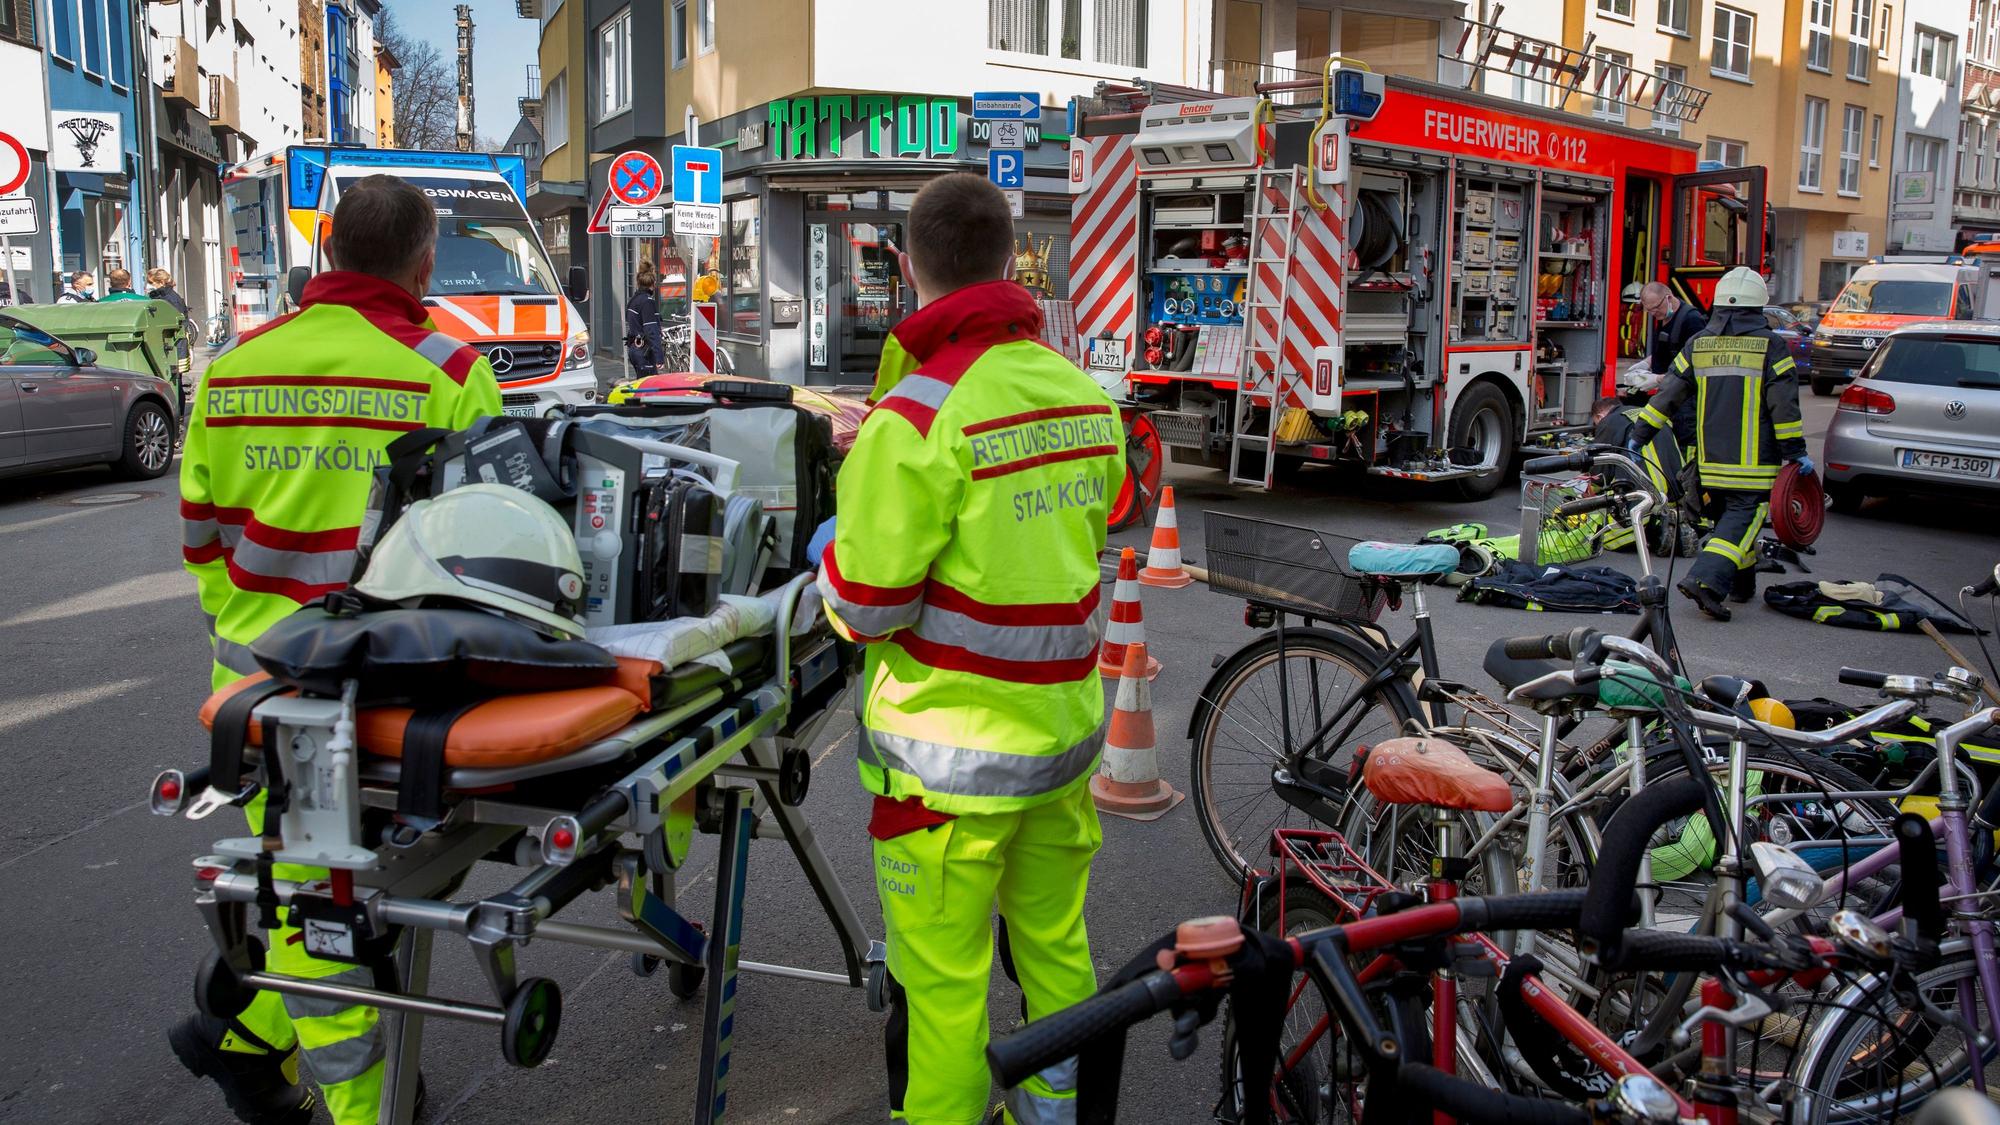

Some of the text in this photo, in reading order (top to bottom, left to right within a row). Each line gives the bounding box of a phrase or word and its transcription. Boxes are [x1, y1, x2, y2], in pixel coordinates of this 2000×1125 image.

[976, 101, 1022, 109] Einbahnstraße
[768, 95, 958, 160] TATTOO
[1424, 109, 1587, 164] FEUERWEHR 112
[998, 154, 1016, 183] P
[423, 188, 514, 203] GSWAGEN
[677, 209, 717, 220] Keine Wende-
[615, 224, 655, 232] ab 11.01.21
[680, 219, 715, 230] möglichkeit
[1104, 341, 1110, 353] K
[1696, 337, 1766, 350] BERUFSFEUERWEHR
[1712, 352, 1742, 366] KÖLN
[207, 388, 427, 421] RETTUNGSDIENST
[971, 417, 1113, 467] RETTUNGSDIENST
[315, 440, 381, 474] KÖLN
[1912, 453, 1921, 465] K
[1058, 473, 1105, 509] KÖLN
[881, 855, 921, 876] STADT
[882, 877, 915, 896] KÖLN
